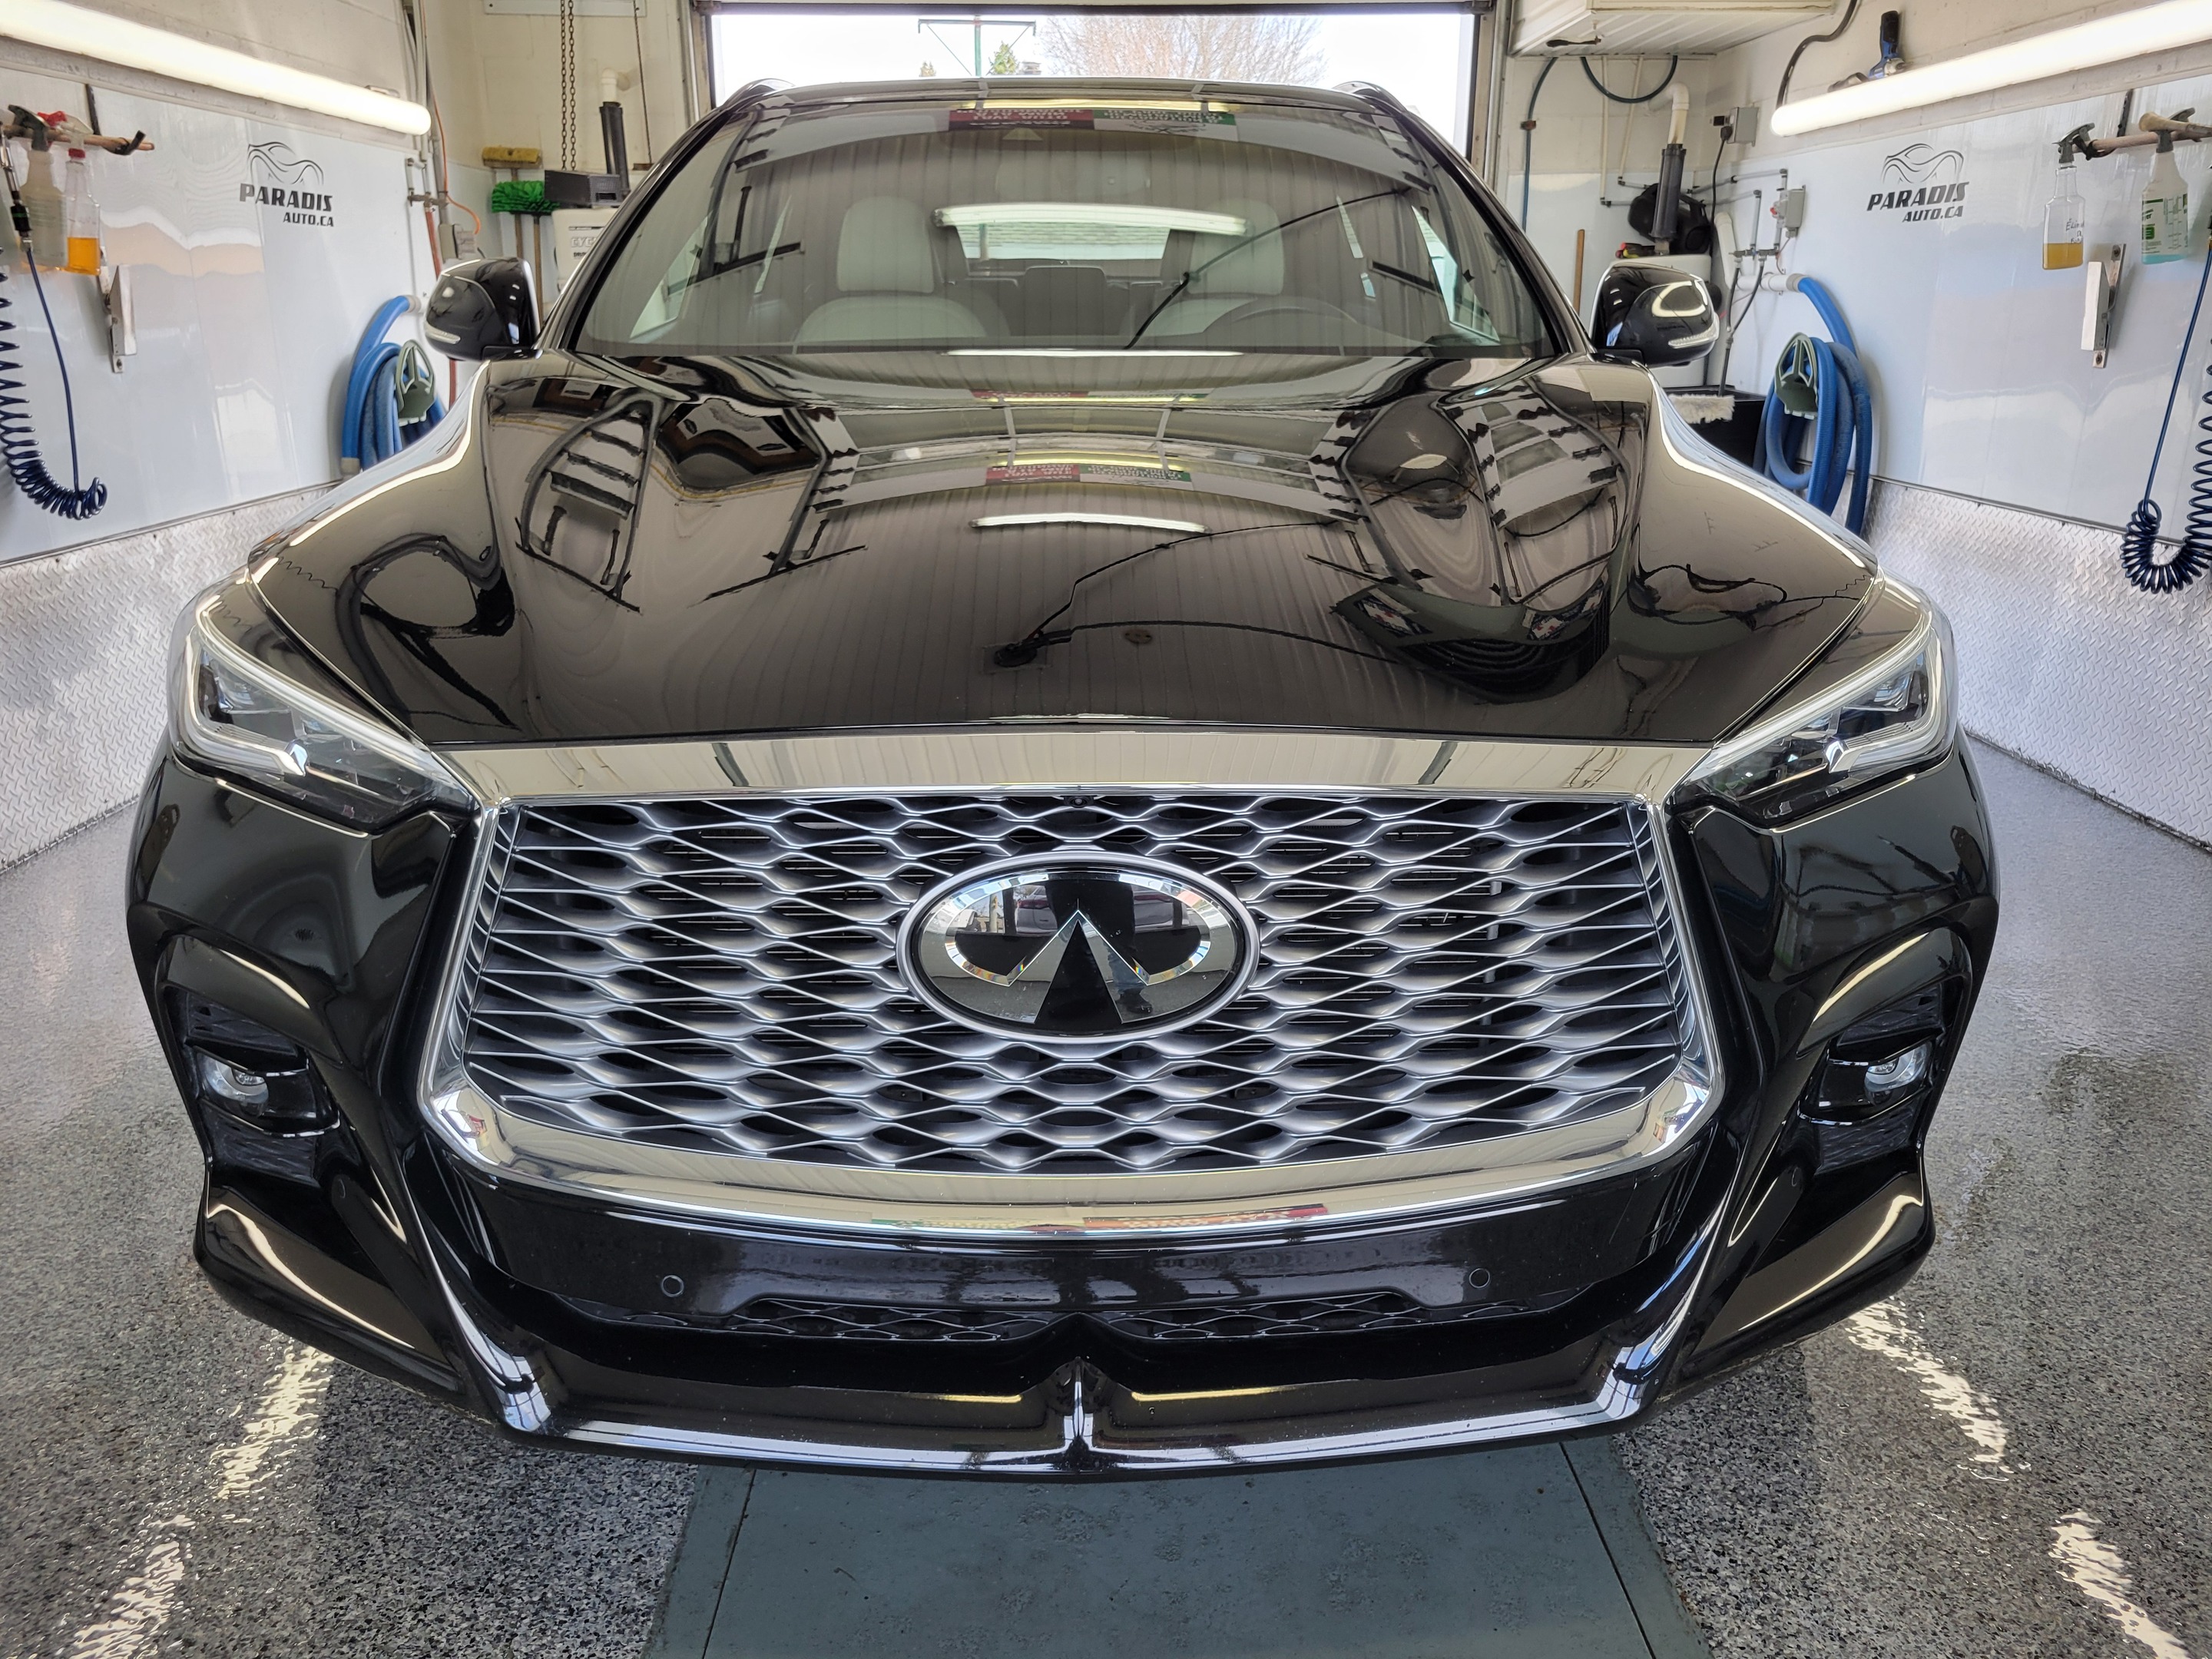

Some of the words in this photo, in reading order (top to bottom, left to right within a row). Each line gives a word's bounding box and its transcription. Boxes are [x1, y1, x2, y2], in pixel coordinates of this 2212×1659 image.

[240, 184, 333, 212] PARADIS
[1867, 182, 1970, 210] PARADIS
[283, 212, 334, 227] AUTO.CA
[1902, 206, 1964, 223] AUTO.CA
